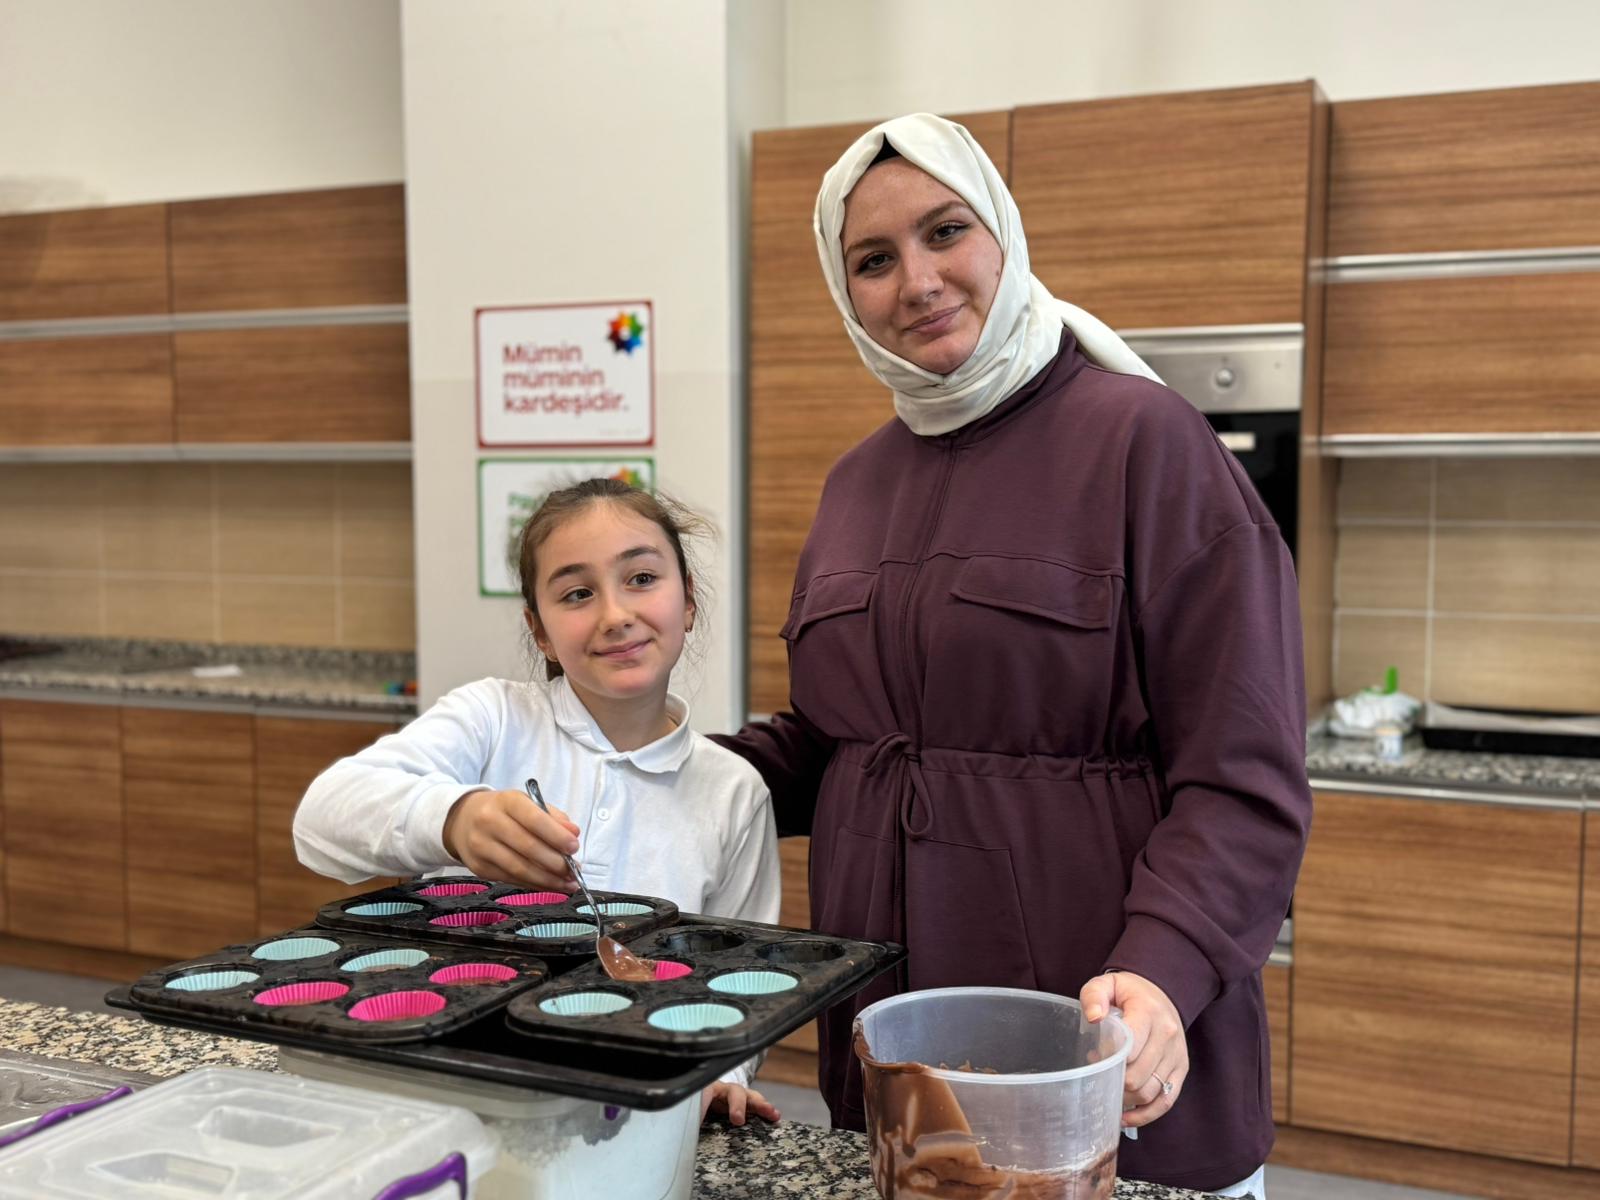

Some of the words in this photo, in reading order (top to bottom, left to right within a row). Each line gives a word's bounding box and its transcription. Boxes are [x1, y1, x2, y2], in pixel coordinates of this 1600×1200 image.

[503, 342, 583, 364] Mümin
[503, 366, 605, 388] müminin
[503, 389, 630, 417] kardeşidir.
